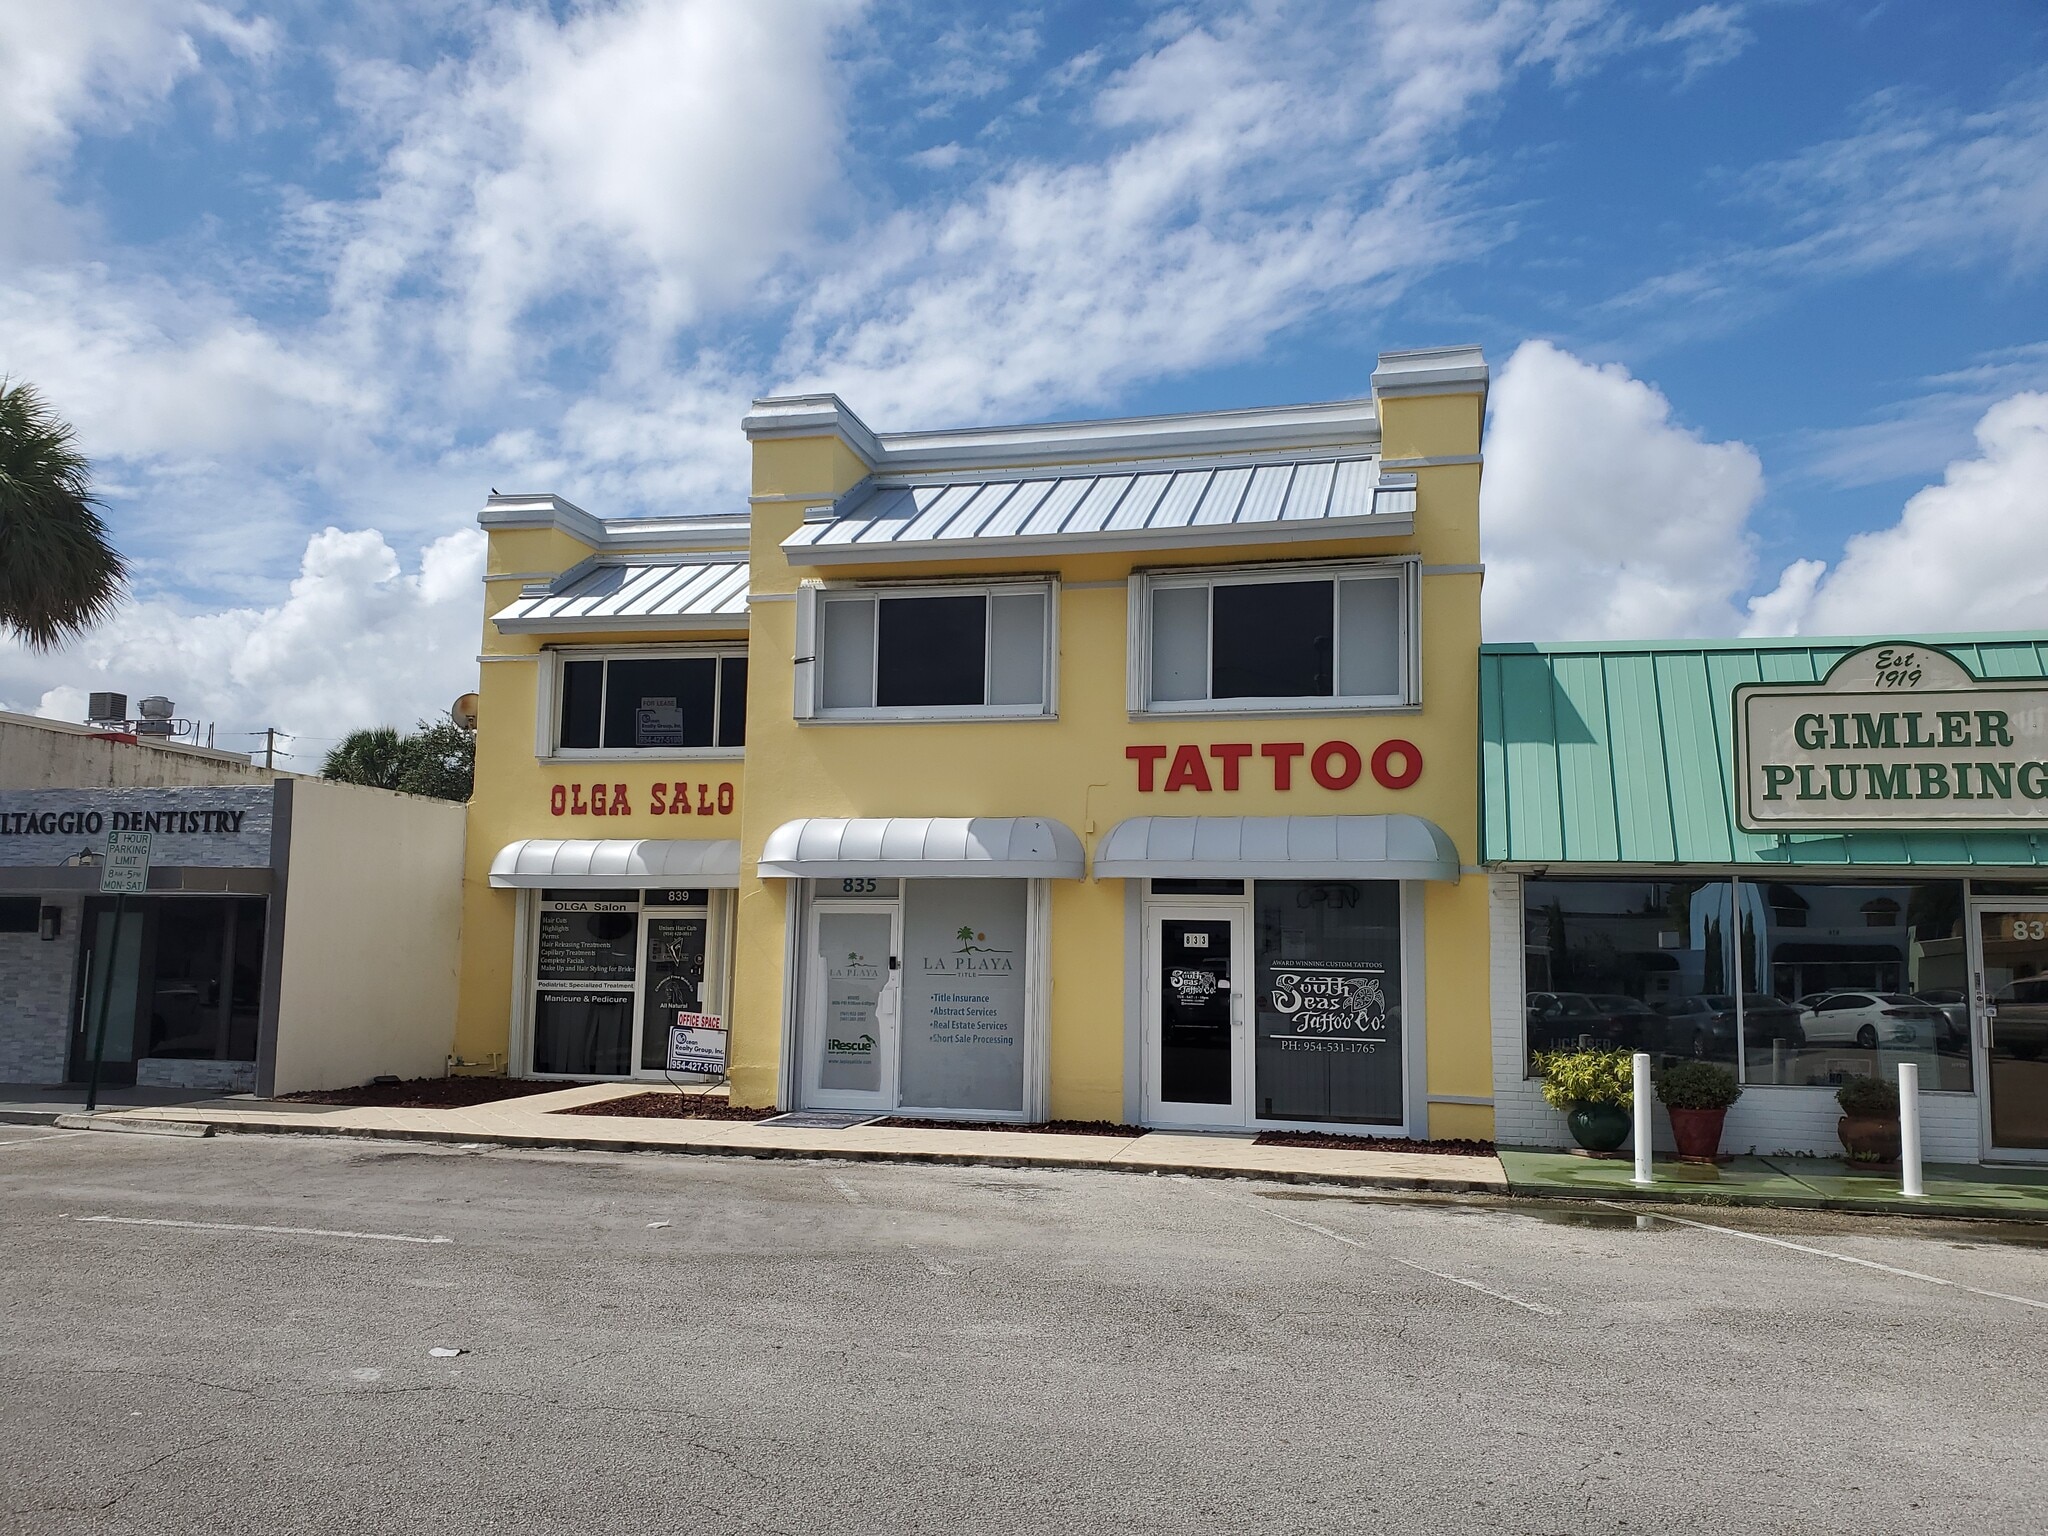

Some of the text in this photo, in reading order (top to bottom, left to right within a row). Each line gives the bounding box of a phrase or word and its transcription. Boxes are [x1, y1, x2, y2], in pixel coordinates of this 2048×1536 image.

[1875, 650, 1921, 670] Est.
[1875, 668, 1922, 687] 1919
[1793, 710, 2014, 750] GIMLER
[1126, 739, 1423, 791] TATTOO
[1761, 761, 2048, 800] PLUMBING
[551, 782, 734, 816] OLGA SALO
[112, 811, 245, 833] DENTISTRY
[124, 834, 149, 843] HOUR
[109, 845, 147, 854] PARKING
[115, 856, 138, 865] LIMIT
[104, 881, 142, 890] MON-SAT
[843, 878, 877, 892] 835
[668, 891, 689, 901] 839
[594, 903, 626, 911] Salon
[2013, 920, 2048, 940] 83
[1185, 935, 1206, 945] 833
[924, 957, 1012, 970] LA PLAYA
[830, 969, 878, 977] LA PLAYA
[933, 993, 989, 1002] Title Insurance
[933, 1007, 997, 1016] Abstract Services
[679, 1014, 720, 1028] OFFICE SPACE
[933, 1020, 1008, 1030] Real Estate Services
[1292, 1011, 1354, 1033] Tattoo
[828, 1039, 871, 1051] iRescue
[955, 1034, 971, 1043] Sale
[973, 1035, 1013, 1046] Processing
[675, 1044, 693, 1052] Realty
[694, 1046, 713, 1054] Group,
[1281, 1041, 1375, 1053] PH: 954-531-1765
[671, 1060, 723, 1073] 954-427-5100
